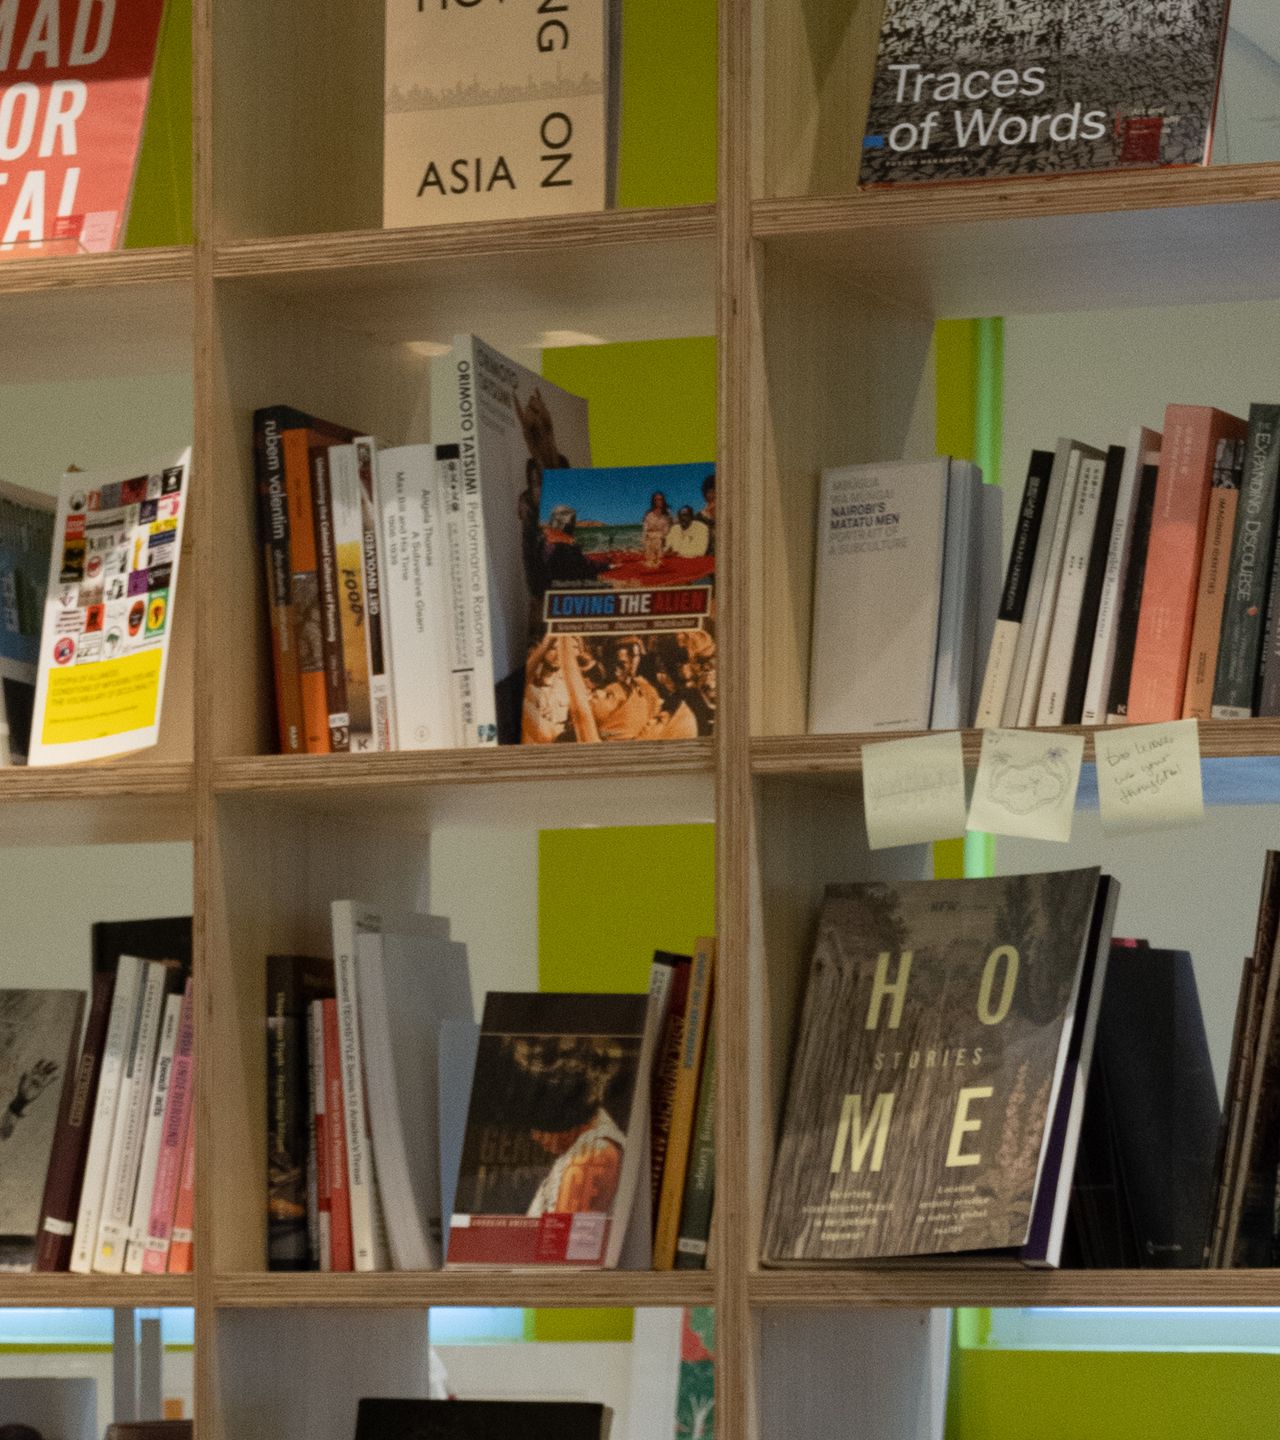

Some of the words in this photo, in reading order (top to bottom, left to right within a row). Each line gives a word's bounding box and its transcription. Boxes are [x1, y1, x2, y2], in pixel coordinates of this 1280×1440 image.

[889, 63, 1046, 104] Traces
[889, 112, 940, 153] of
[955, 102, 1107, 147] Words
[417, 156, 516, 196] ASIA
[541, 112, 573, 188] ON
[455, 359, 475, 432] ORIMOTO
[263, 419, 284, 470] rubem
[460, 434, 478, 495] TATSUMI
[266, 473, 289, 539] valentim
[828, 515, 874, 531] MATATU
[874, 511, 900, 526] MEN
[829, 501, 886, 518] NAIROBI'S
[463, 500, 483, 593] Performance
[872, 1046, 984, 1072] STORIES
